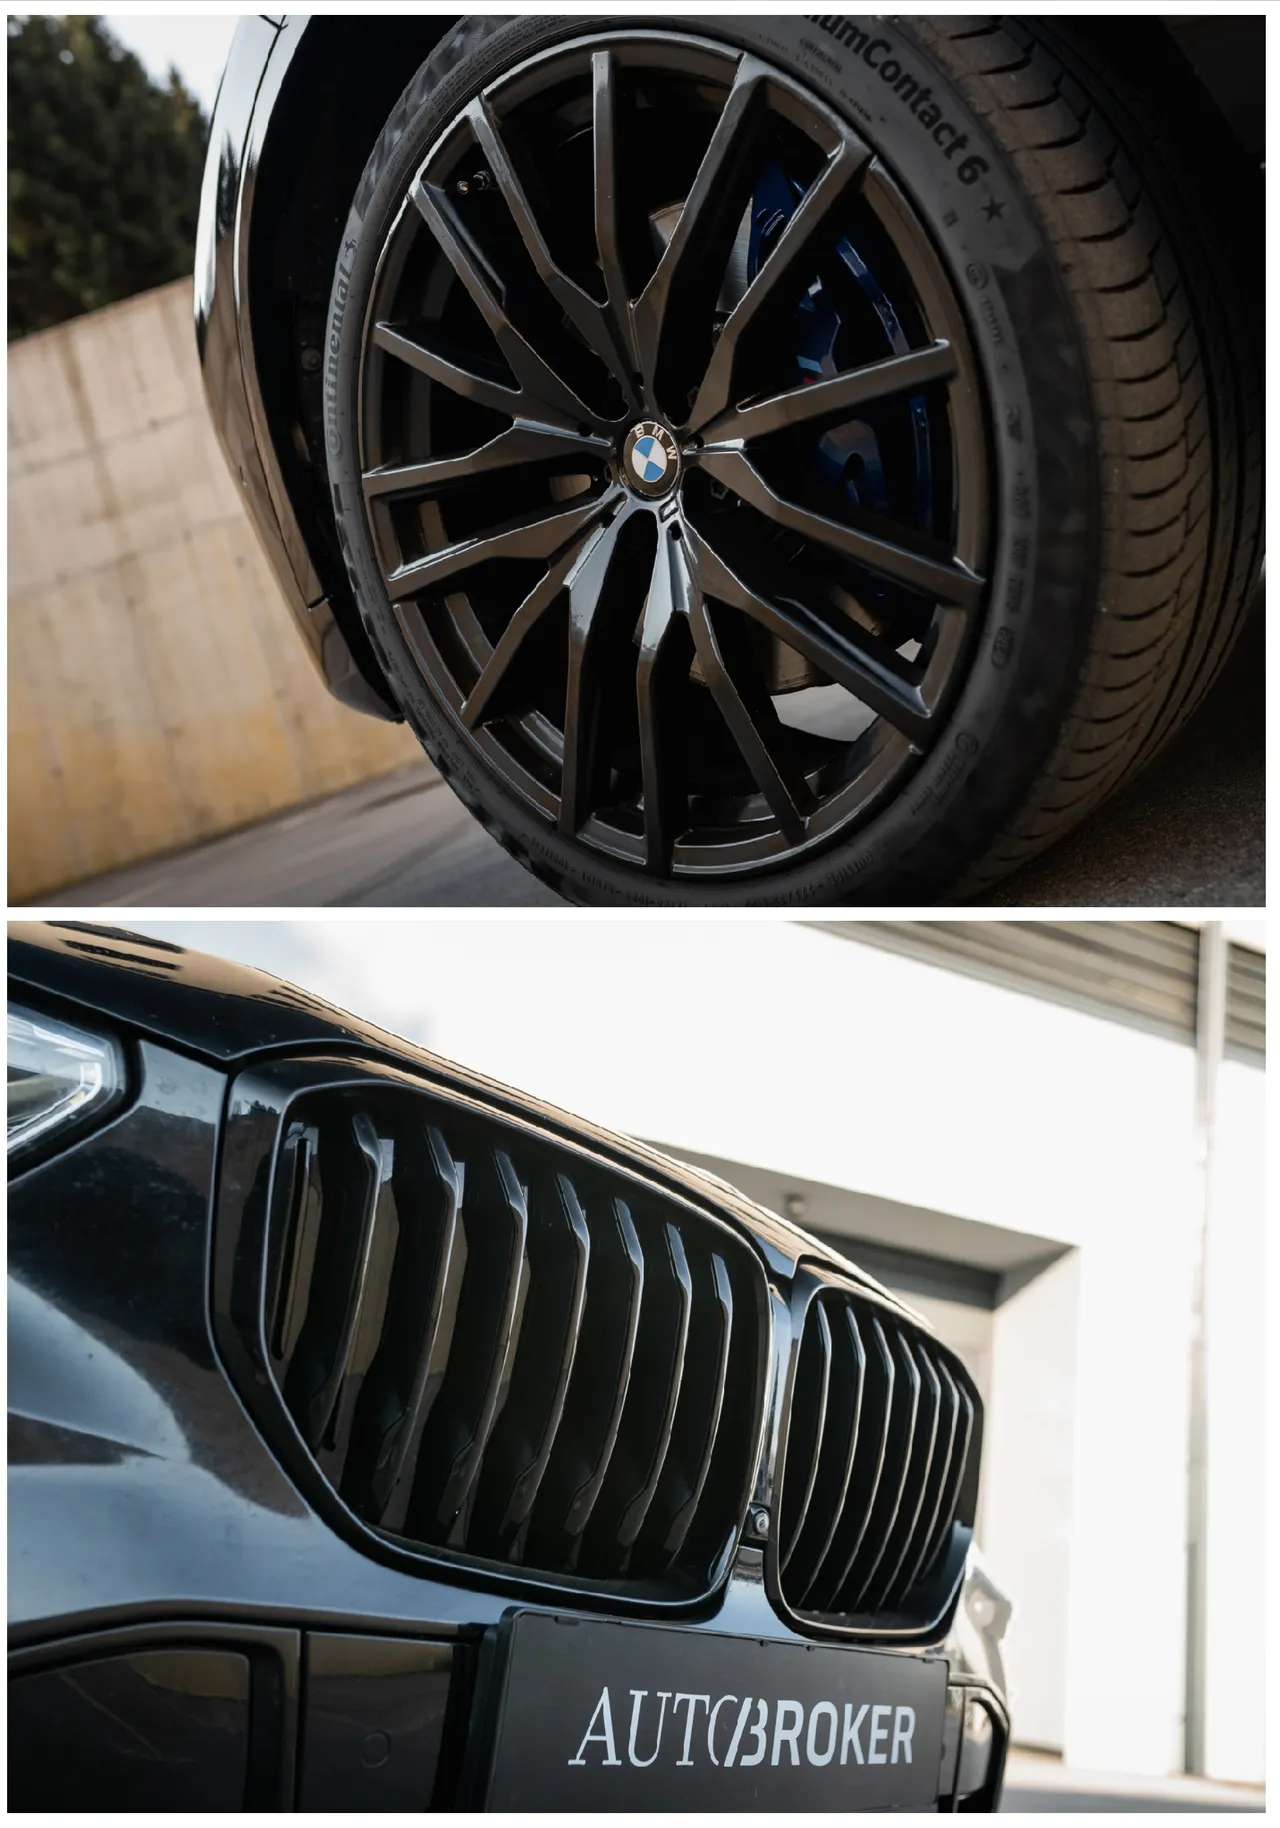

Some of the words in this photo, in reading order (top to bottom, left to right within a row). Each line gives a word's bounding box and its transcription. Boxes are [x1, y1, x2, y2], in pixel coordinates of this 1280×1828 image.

[956, 155, 991, 186] 6
[325, 262, 353, 463] Continental
[634, 423, 678, 460] BMW
